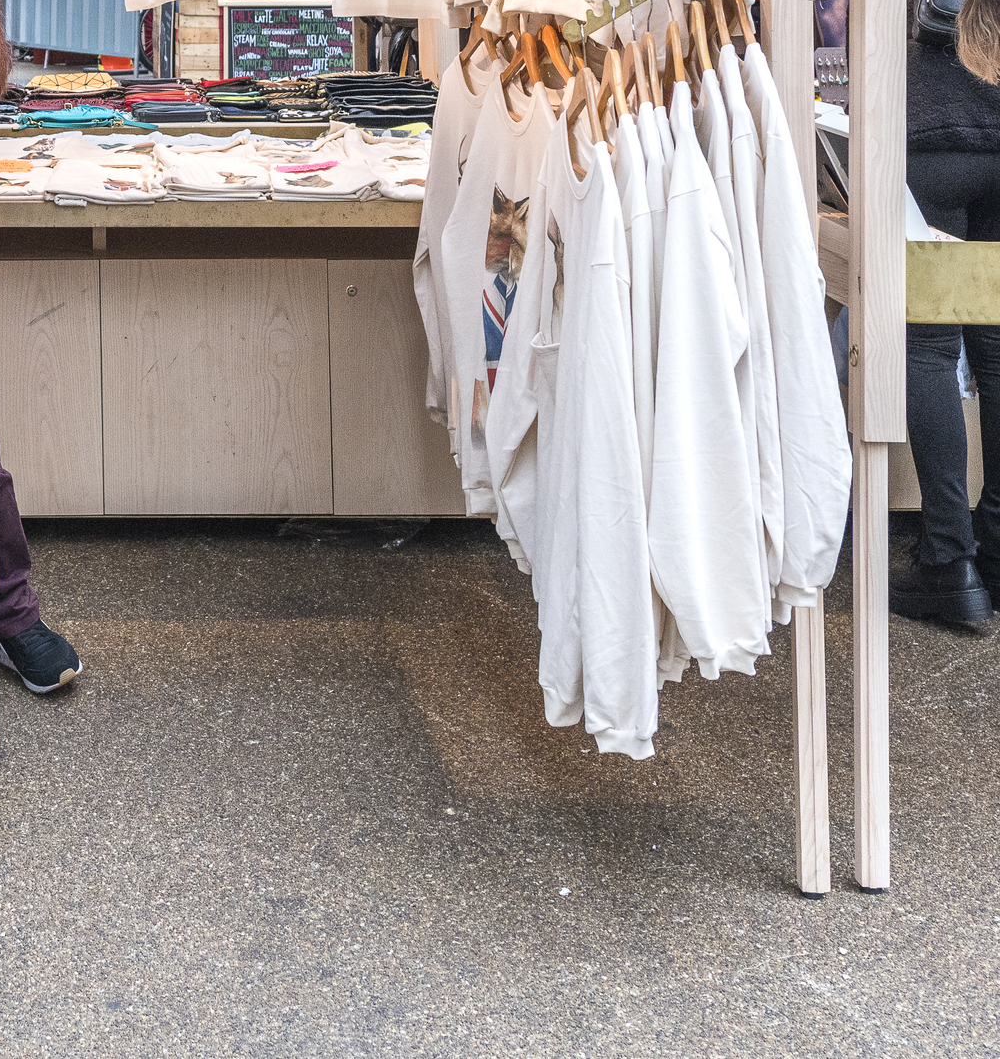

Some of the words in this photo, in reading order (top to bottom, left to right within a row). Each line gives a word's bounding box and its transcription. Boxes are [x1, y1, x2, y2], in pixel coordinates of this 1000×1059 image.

[234, 10, 254, 23] MILK
[254, 9, 274, 23] LATTE
[298, 9, 325, 19] MEETING
[299, 22, 337, 35] MACCHIATO
[233, 34, 257, 47] STEAM
[306, 34, 329, 47] RELAX
[267, 47, 288, 58] SWEET
[324, 46, 344, 58] SOYA
[329, 58, 353, 68] FOAM
